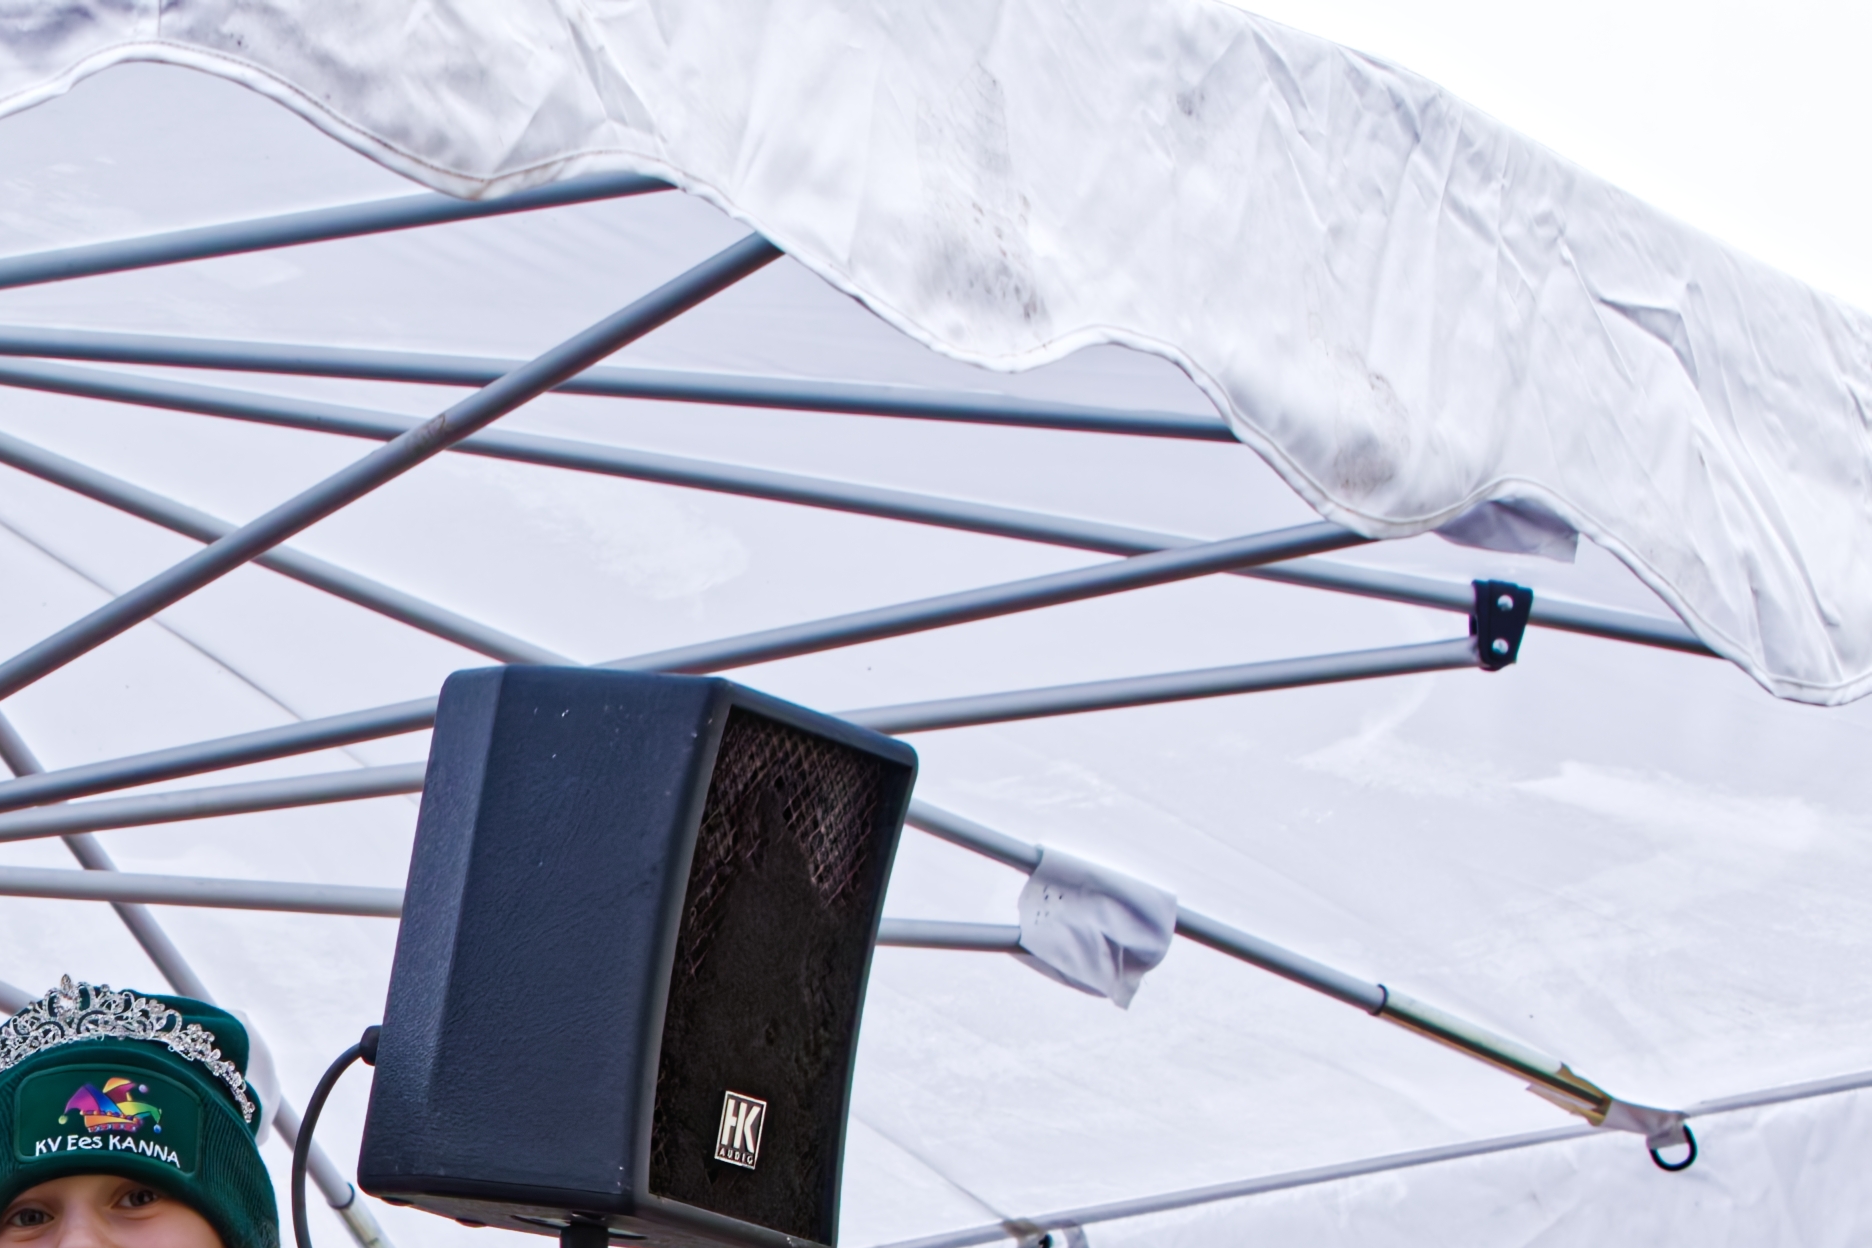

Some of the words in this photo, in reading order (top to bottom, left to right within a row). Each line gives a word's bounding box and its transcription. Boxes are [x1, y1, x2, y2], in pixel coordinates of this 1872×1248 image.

[720, 1098, 762, 1154] HK
[35, 1135, 62, 1157] KV
[66, 1134, 102, 1151] Ees
[108, 1134, 181, 1169] KANNA
[719, 1147, 754, 1165] AUDIO
